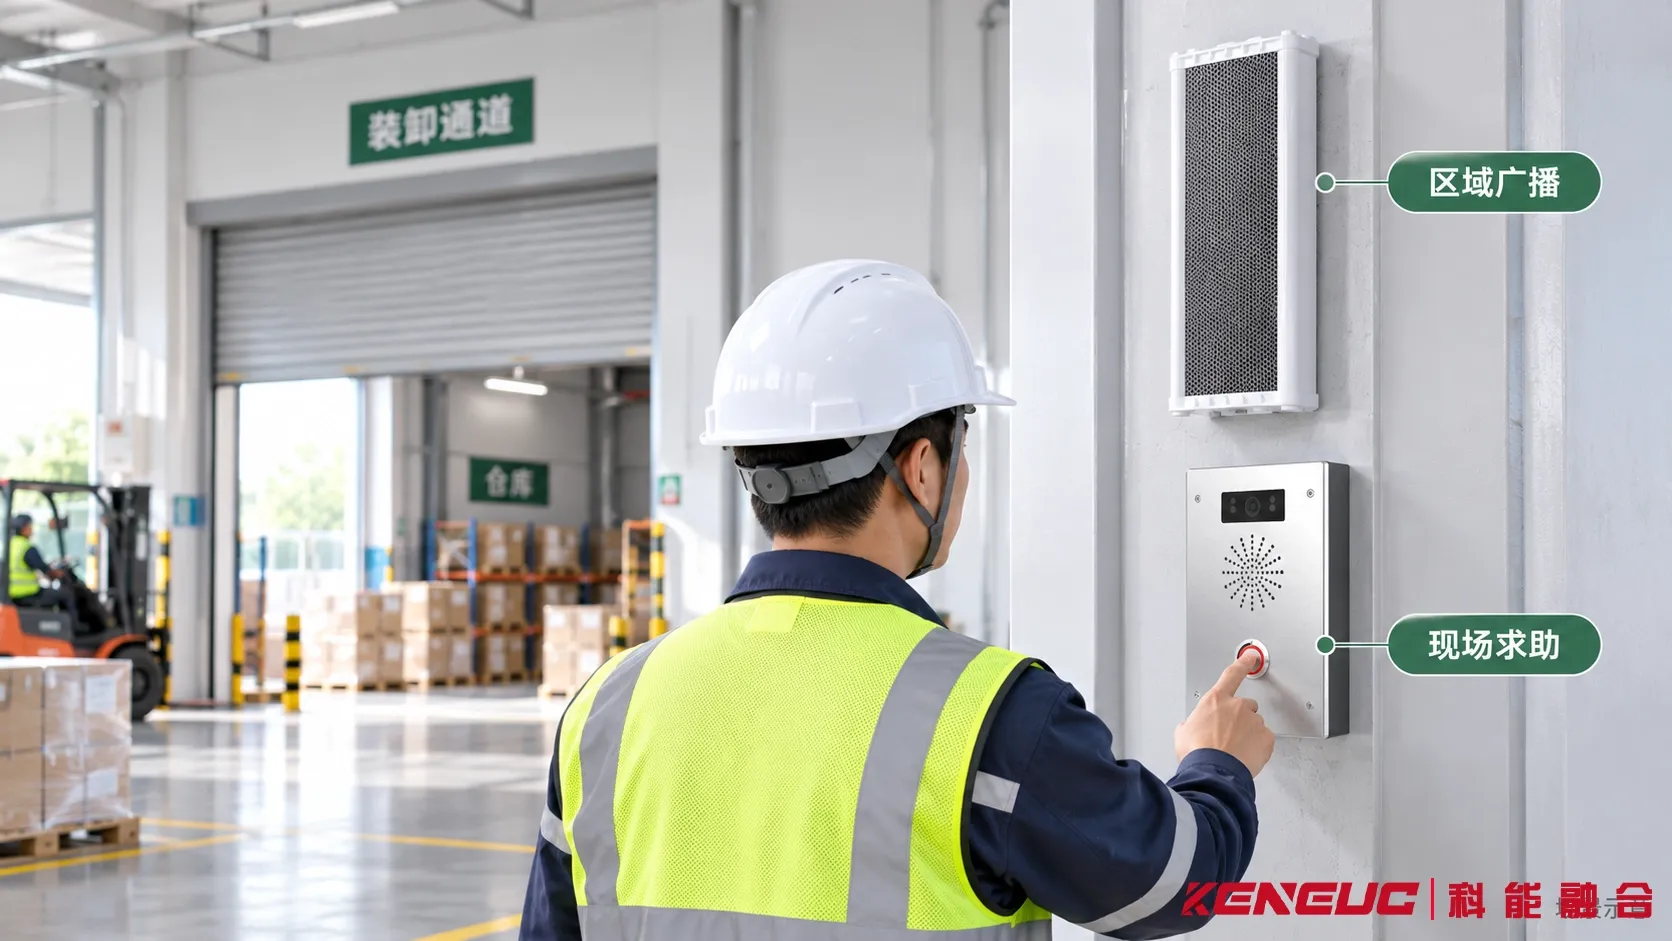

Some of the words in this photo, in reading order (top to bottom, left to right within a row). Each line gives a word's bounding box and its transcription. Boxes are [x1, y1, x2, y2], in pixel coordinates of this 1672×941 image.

[368, 93, 513, 151] 装卸通道
[485, 465, 533, 498] 仓库
